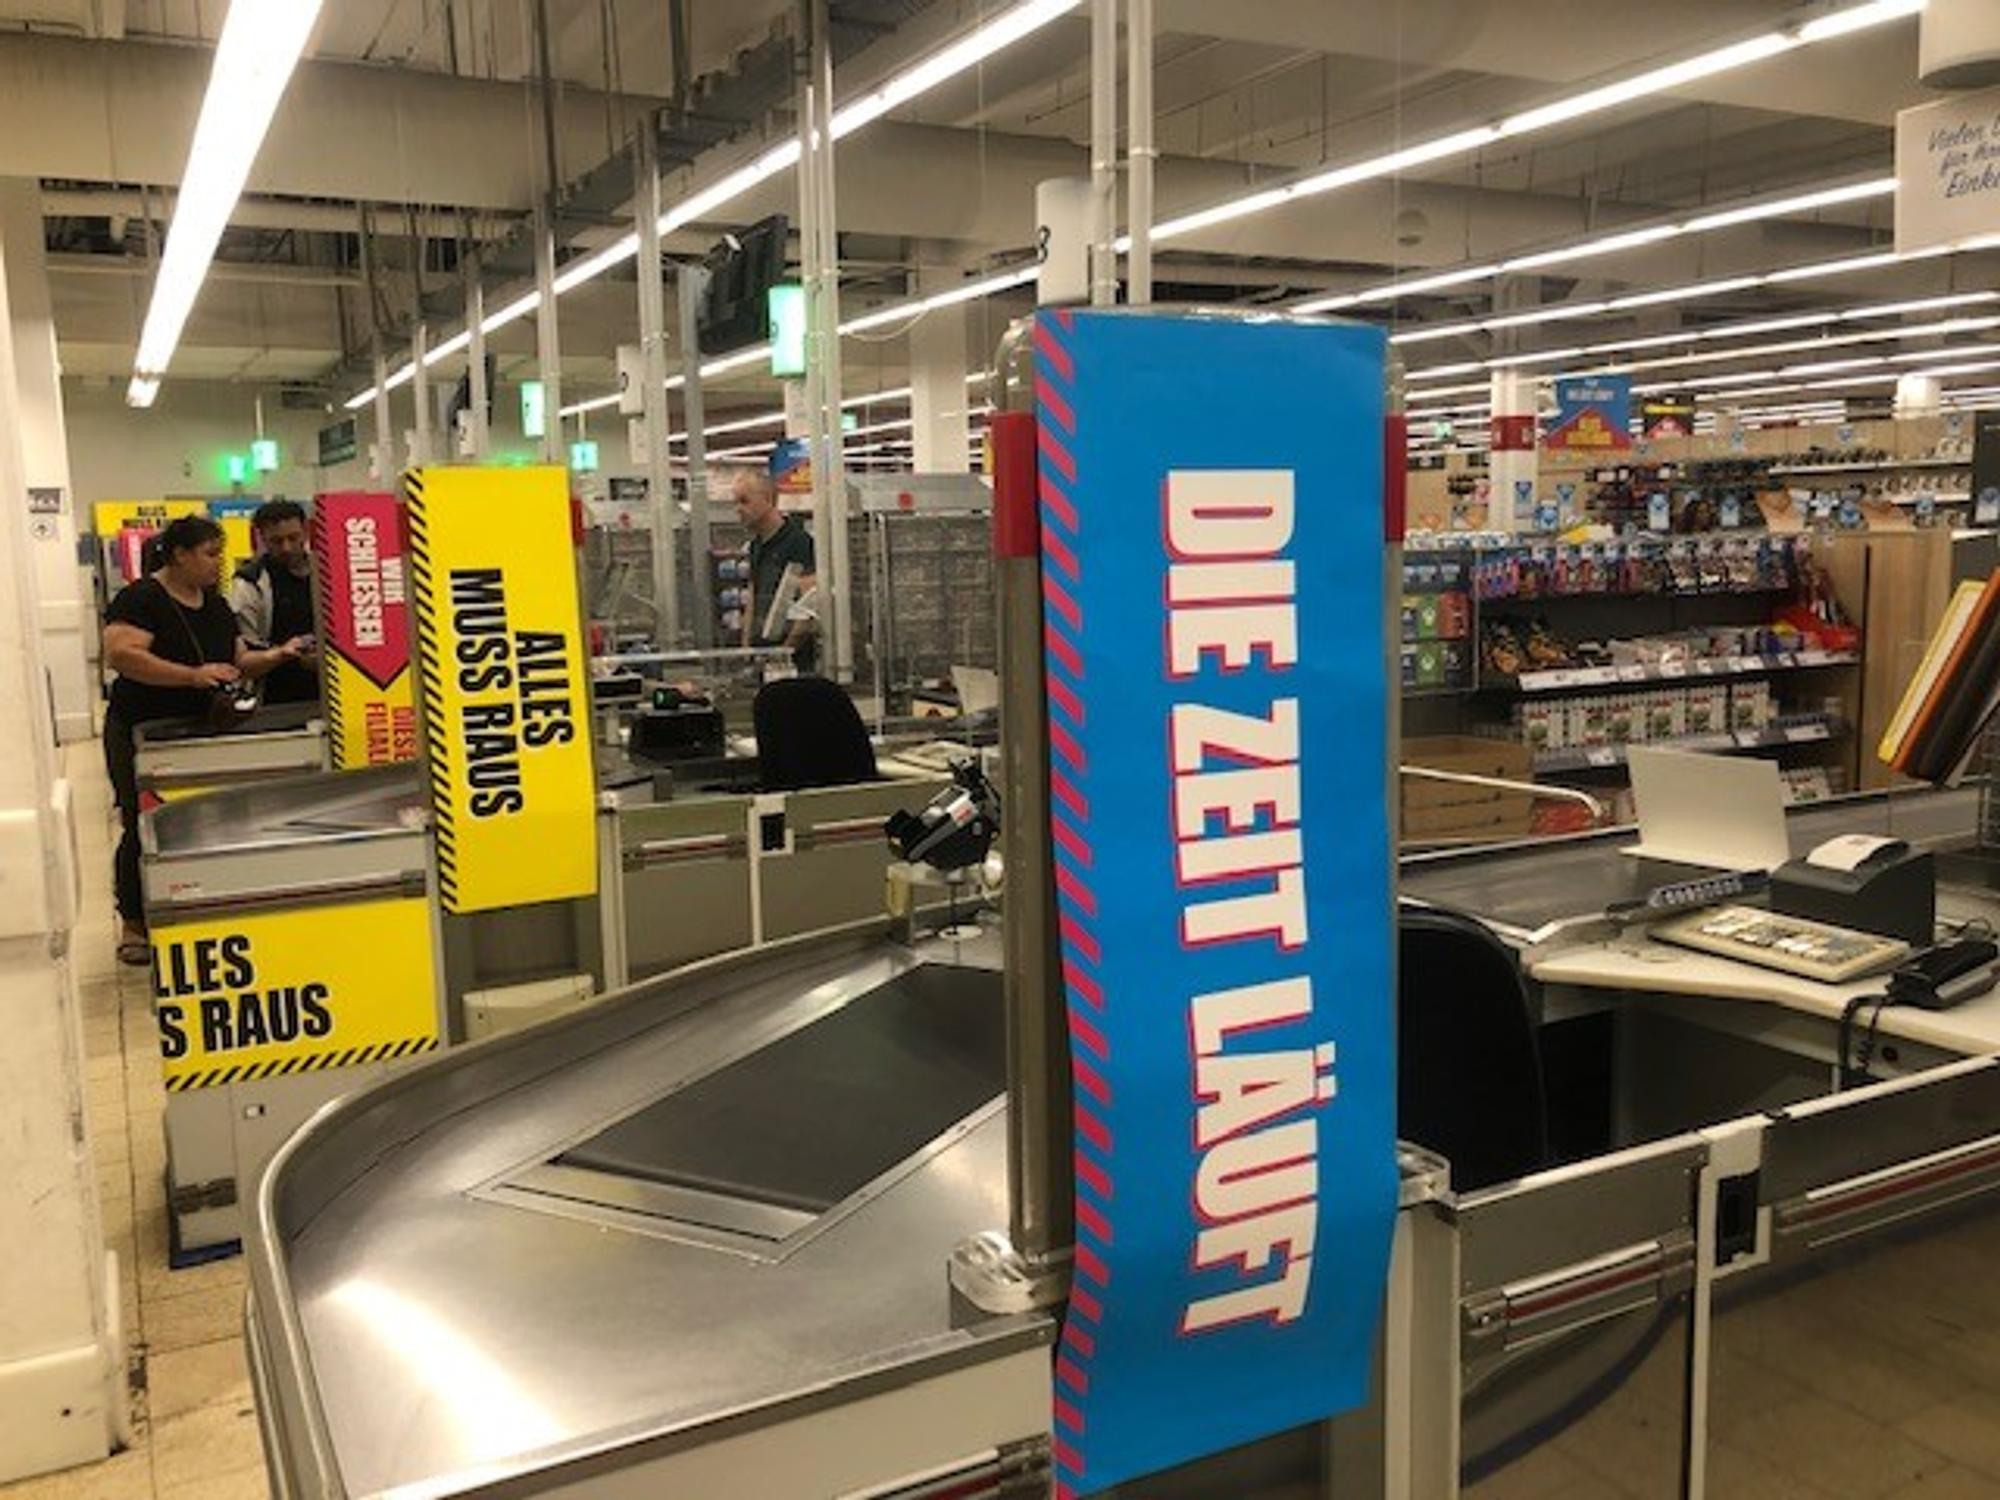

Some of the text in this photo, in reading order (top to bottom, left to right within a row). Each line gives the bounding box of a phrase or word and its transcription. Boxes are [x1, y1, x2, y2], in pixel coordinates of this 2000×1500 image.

[380, 556, 405, 605] WIR
[365, 702, 389, 765] FILIAL
[450, 568, 525, 818] MUSS RAUS
[514, 631, 575, 748] ALLES
[1162, 469, 1337, 1338] DIE ZEIT LÄUFT
[201, 983, 333, 1053] RAUS
